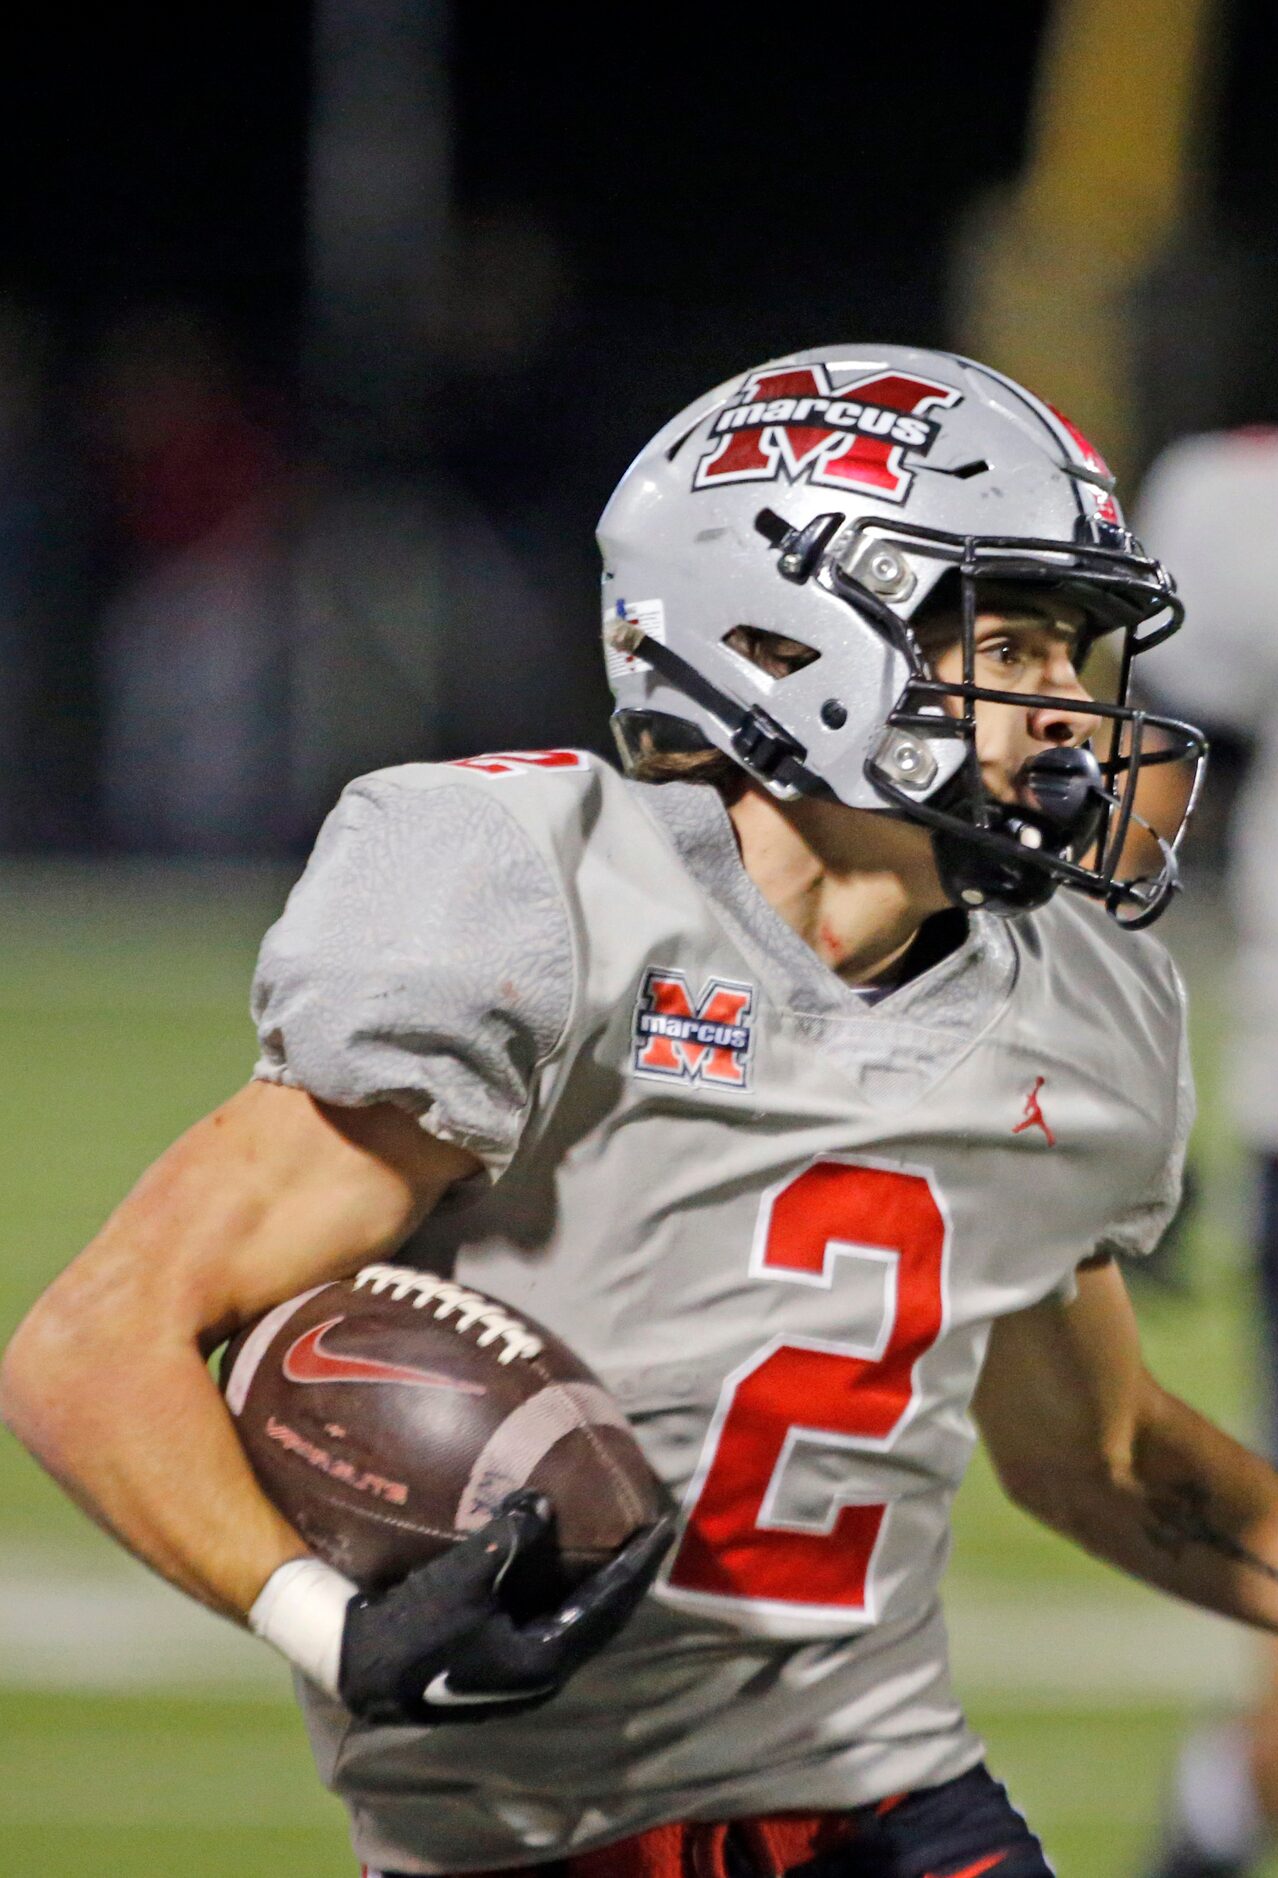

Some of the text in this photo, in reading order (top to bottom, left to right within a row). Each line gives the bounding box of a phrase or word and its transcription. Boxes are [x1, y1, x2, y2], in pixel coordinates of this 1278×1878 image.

[694, 364, 962, 506] M
[715, 398, 931, 446] marcus
[635, 973, 751, 1087] M
[640, 1014, 748, 1049] marcus
[650, 1152, 954, 1625] 2
